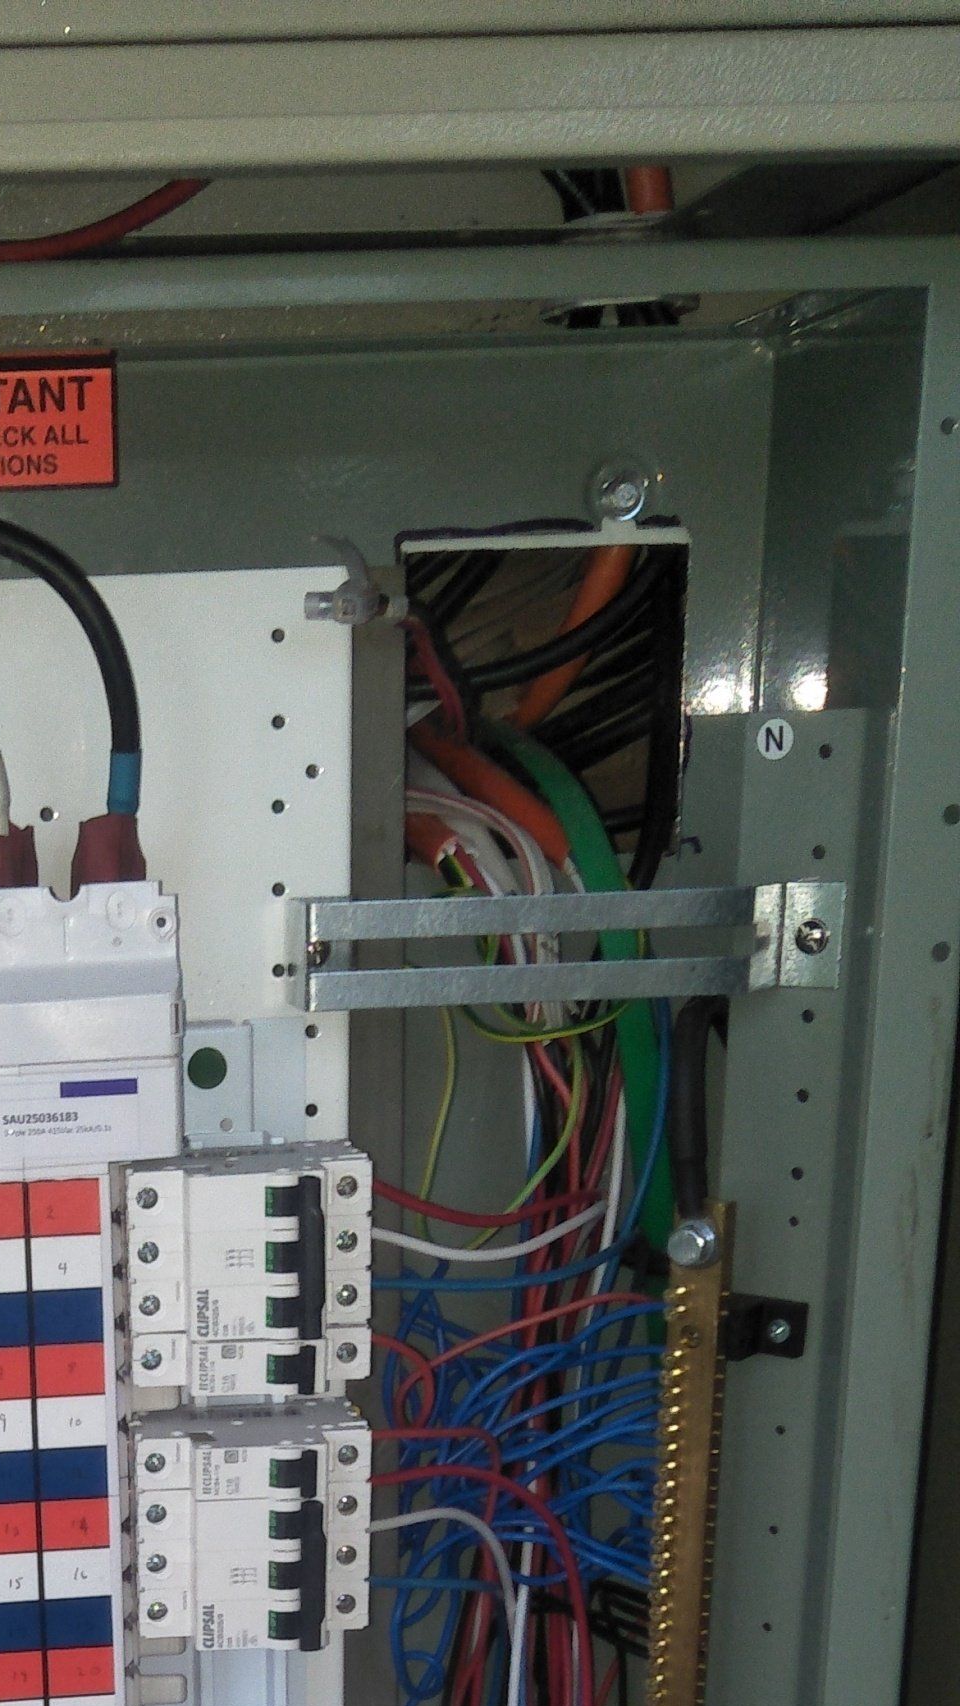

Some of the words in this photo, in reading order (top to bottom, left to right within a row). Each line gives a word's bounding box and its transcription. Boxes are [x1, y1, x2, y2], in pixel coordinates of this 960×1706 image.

[44, 425, 89, 446] ALL
[765, 725, 783, 752] N
[58, 1262, 68, 1276] 4
[197, 1290, 209, 1337] CLIPSAL
[9, 1577, 24, 1589] 15
[73, 1567, 88, 1580] 16
[202, 1604, 215, 1649] CLIPSAL
